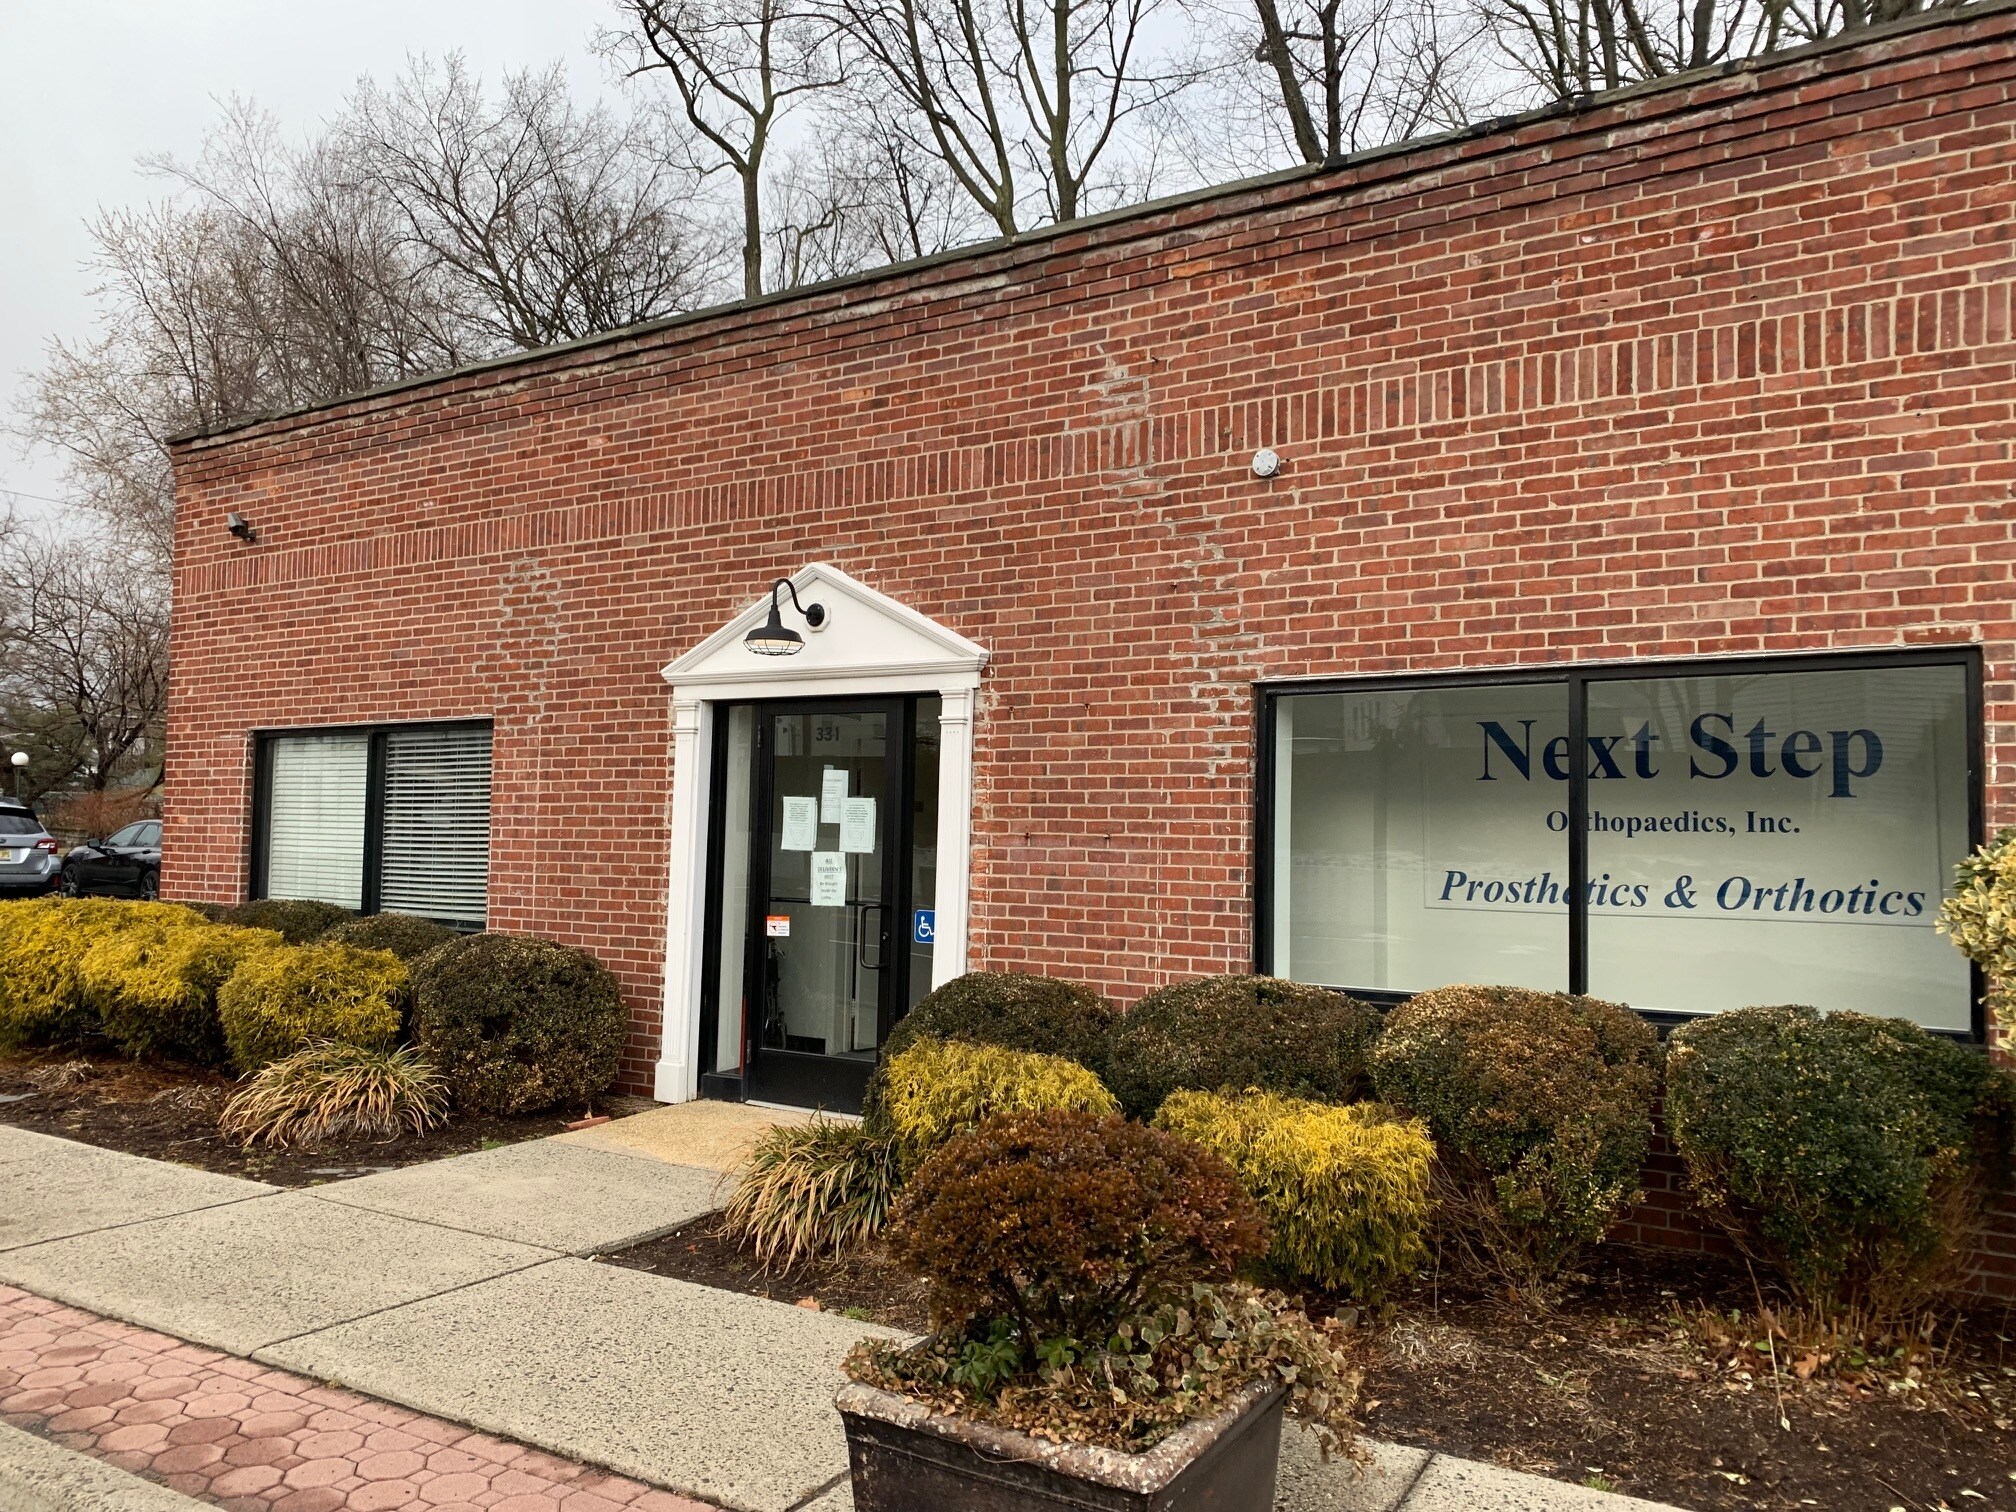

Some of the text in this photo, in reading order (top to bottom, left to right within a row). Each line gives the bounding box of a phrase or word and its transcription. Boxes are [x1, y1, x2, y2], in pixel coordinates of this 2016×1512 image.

[815, 726, 840, 742] 331
[1475, 712, 1883, 798] Next Step
[1546, 810, 1801, 838] Othopaedics, Inc.
[1664, 875, 1697, 909] &
[1716, 876, 1926, 917] Orthotics
